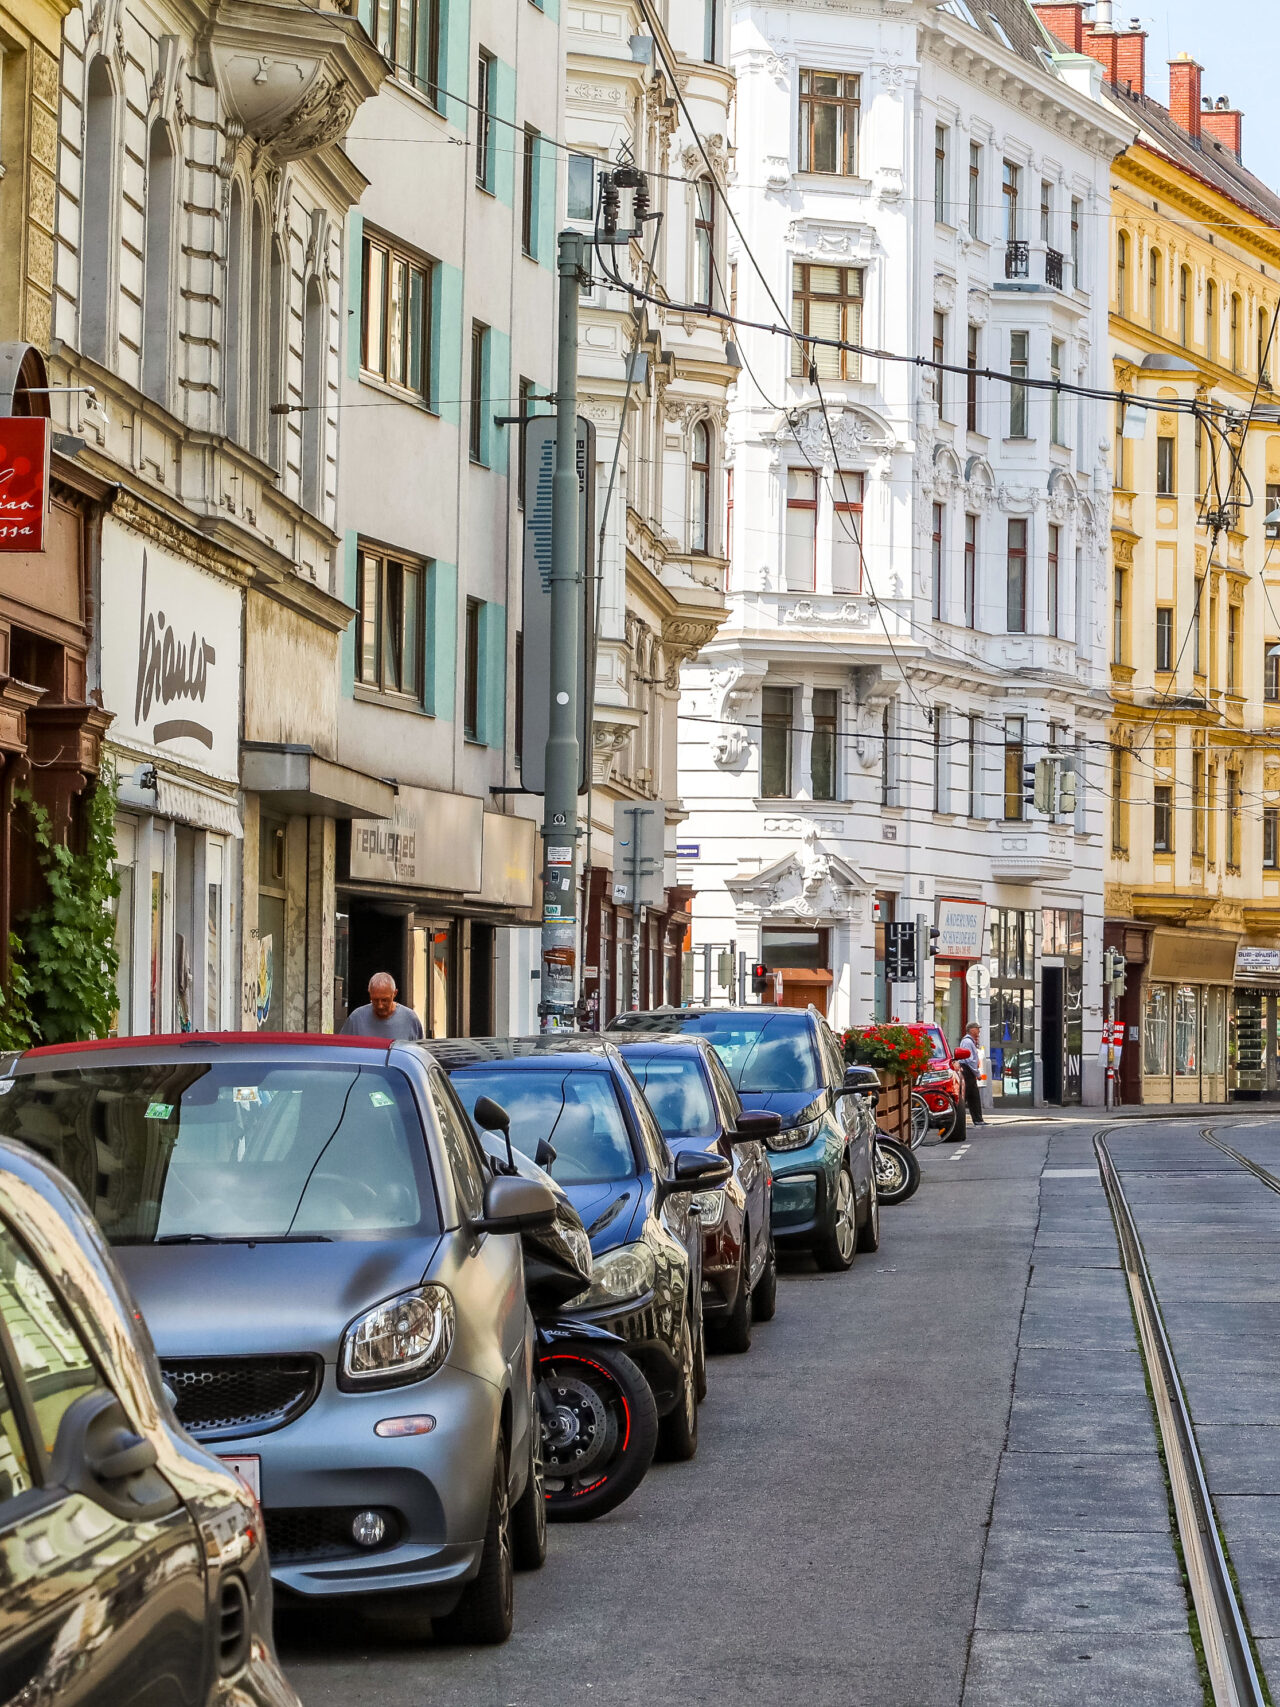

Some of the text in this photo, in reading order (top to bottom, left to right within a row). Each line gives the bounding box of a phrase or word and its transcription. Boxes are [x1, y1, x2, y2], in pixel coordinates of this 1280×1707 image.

[0, 494, 35, 511] iao
[134, 547, 216, 727] bianco
[356, 825, 416, 863] replugged
[942, 930, 977, 945] SCHNEIDEREI
